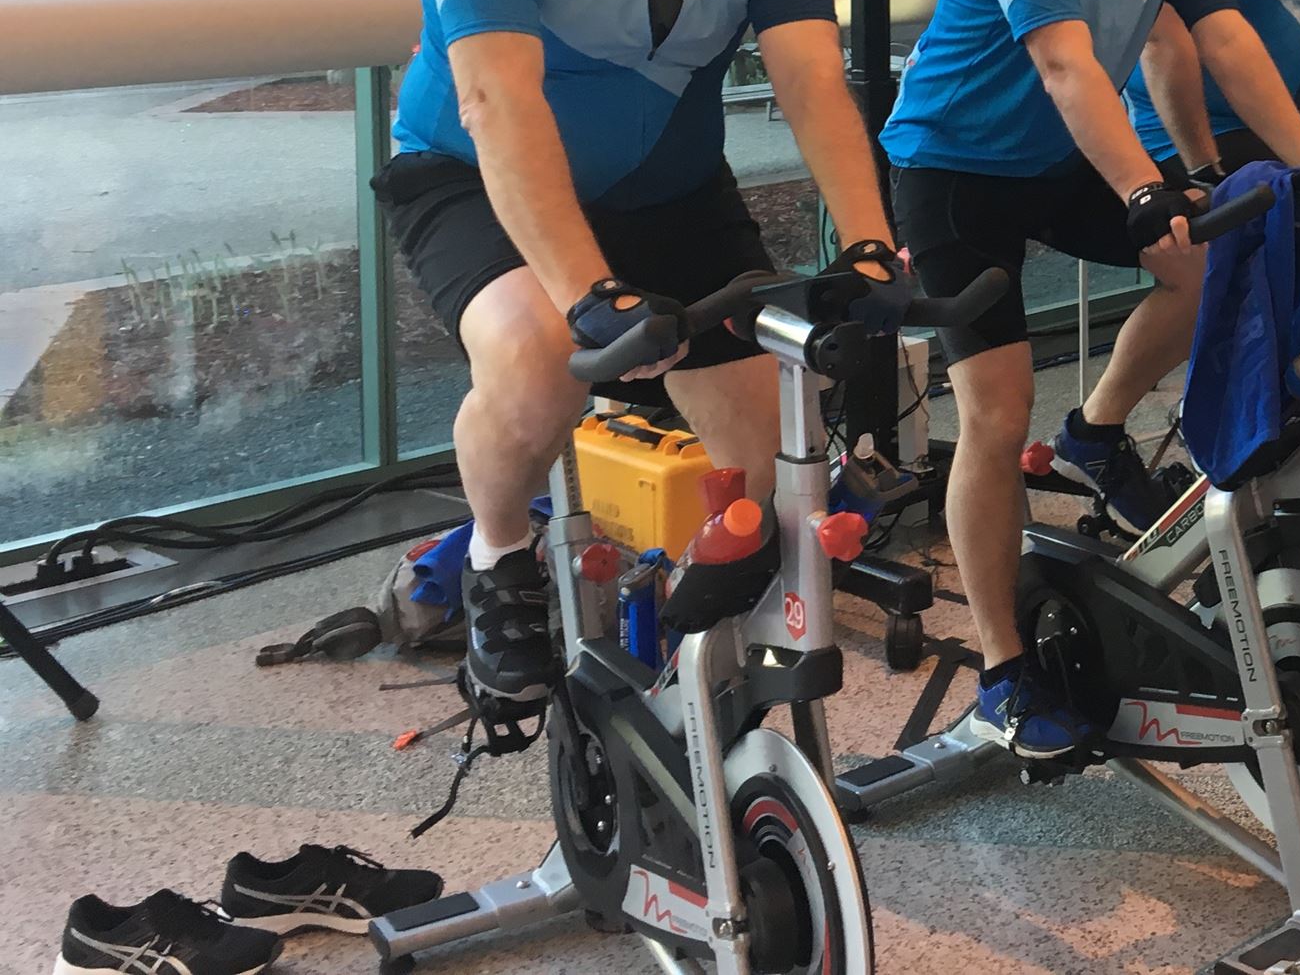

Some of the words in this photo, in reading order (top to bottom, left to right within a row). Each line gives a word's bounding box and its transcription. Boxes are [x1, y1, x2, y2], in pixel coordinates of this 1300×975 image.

[1166, 499, 1206, 544] CARBO
[784, 597, 804, 629] 29
[1218, 549, 1257, 683] FREEMOTION
[1180, 730, 1236, 743] FREEMOTION
[687, 701, 716, 869] FREEMOTION
